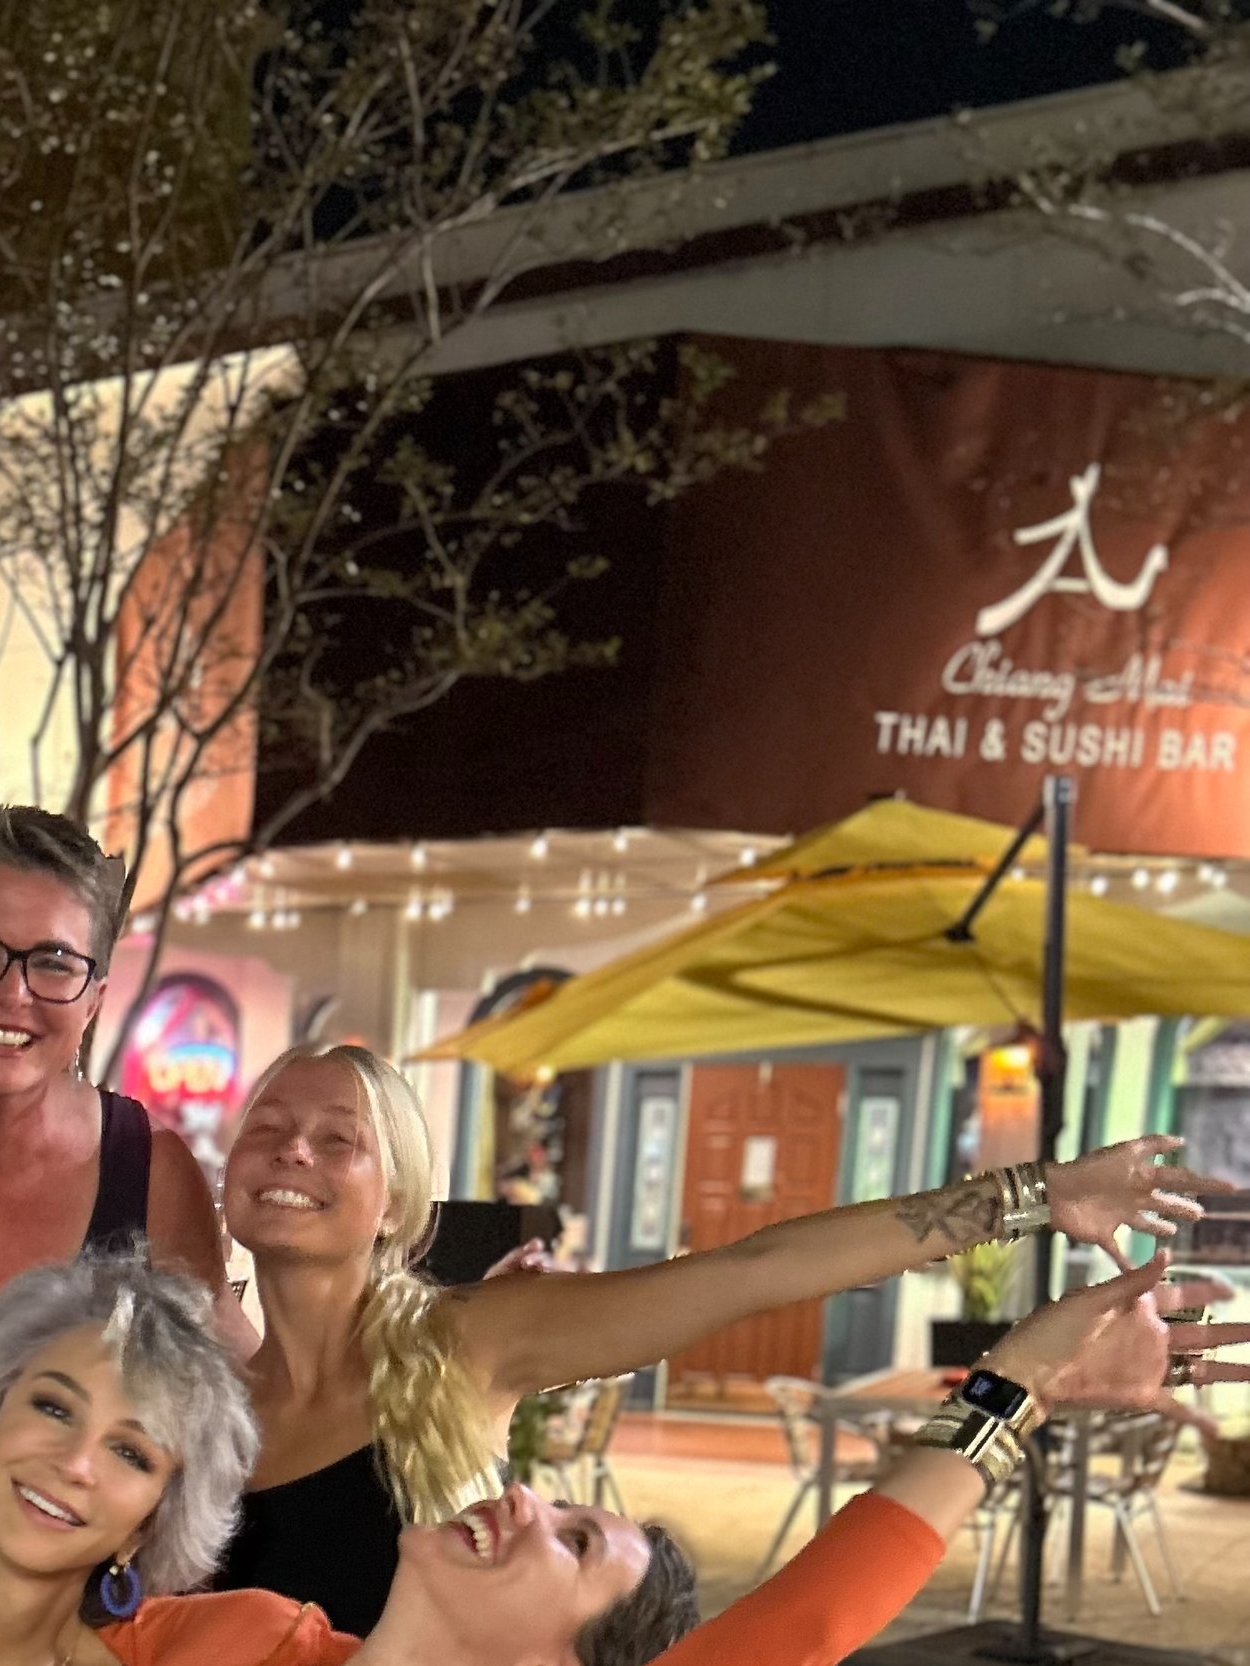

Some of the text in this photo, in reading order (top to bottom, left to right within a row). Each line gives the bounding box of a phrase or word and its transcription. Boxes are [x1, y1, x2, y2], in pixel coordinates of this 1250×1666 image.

[943, 640, 1075, 721] Chiang
[876, 711, 1236, 771] THAI & SUSHI BAR
